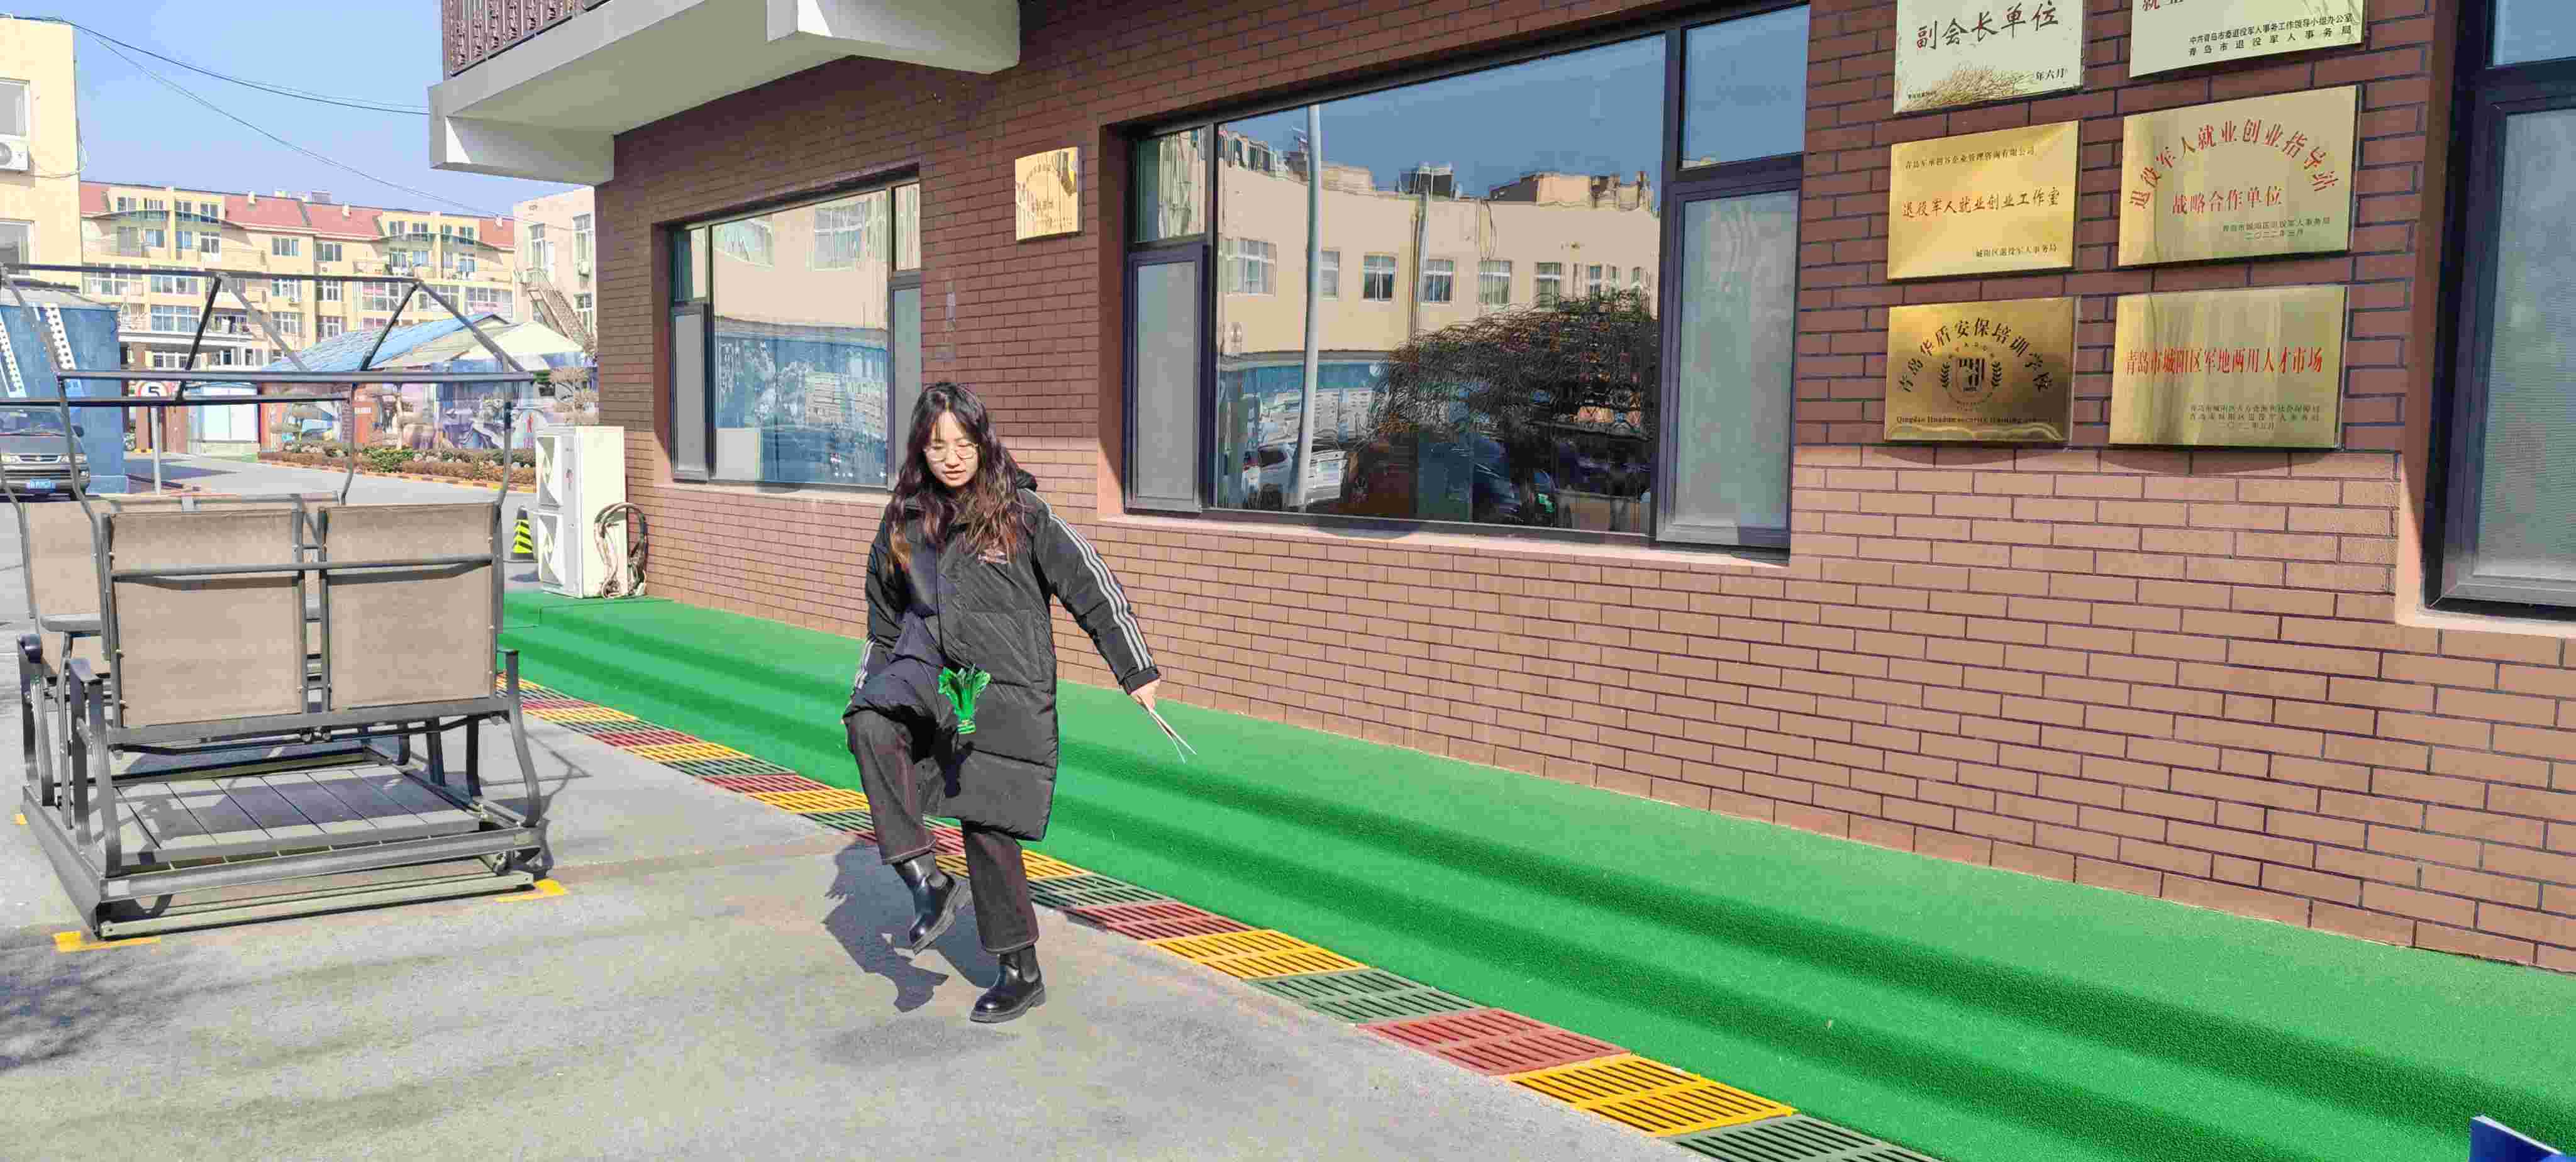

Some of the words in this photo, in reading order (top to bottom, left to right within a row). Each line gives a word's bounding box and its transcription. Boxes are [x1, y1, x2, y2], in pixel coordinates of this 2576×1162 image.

[1916, 0, 2058, 50] 副会长单位
[2189, 26, 2351, 56] 青岛市退役军人事务局
[2129, 119, 2338, 209] 退役军人就业创业指导站
[1902, 187, 2060, 218] 退役军人就业创业工作室
[2172, 186, 2282, 214] 战略合作单位
[1899, 318, 2053, 392] 青岛华盾安保培训学校
[2127, 347, 2323, 375] 青岛市城阳区军地两用人才市场
